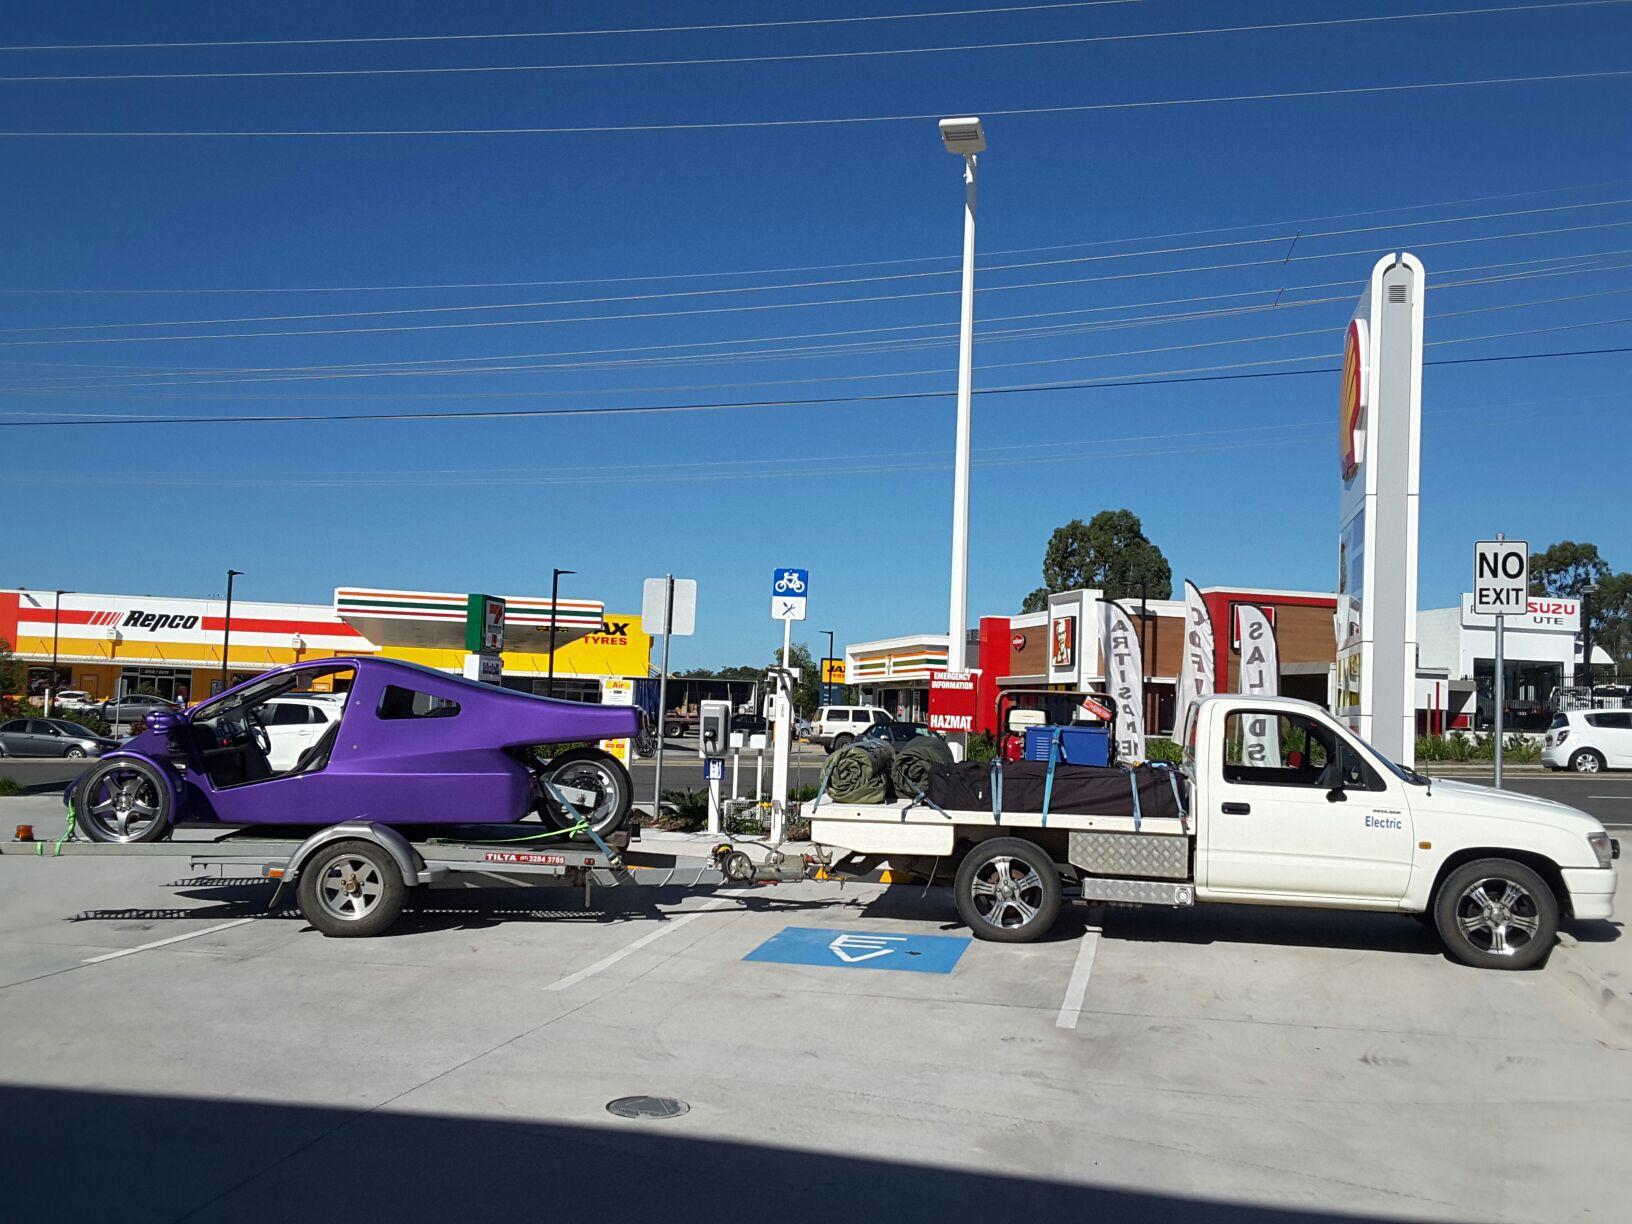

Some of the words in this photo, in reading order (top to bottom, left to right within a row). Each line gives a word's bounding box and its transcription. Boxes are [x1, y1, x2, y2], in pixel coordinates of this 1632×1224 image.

[1478, 551, 1525, 580] NO
[1478, 587, 1524, 606] EXIT
[1527, 602, 1575, 615] SUZU
[122, 610, 199, 632] Repco
[1533, 616, 1564, 626] UTE
[592, 622, 630, 636] AX
[584, 636, 628, 646] TYRES
[933, 672, 971, 681] EMERGENCY
[612, 681, 624, 689] Air
[931, 681, 974, 690] INFORMATION
[930, 714, 973, 730] HAZMAT
[1364, 815, 1402, 830] Electric
[486, 853, 517, 861] TILTA
